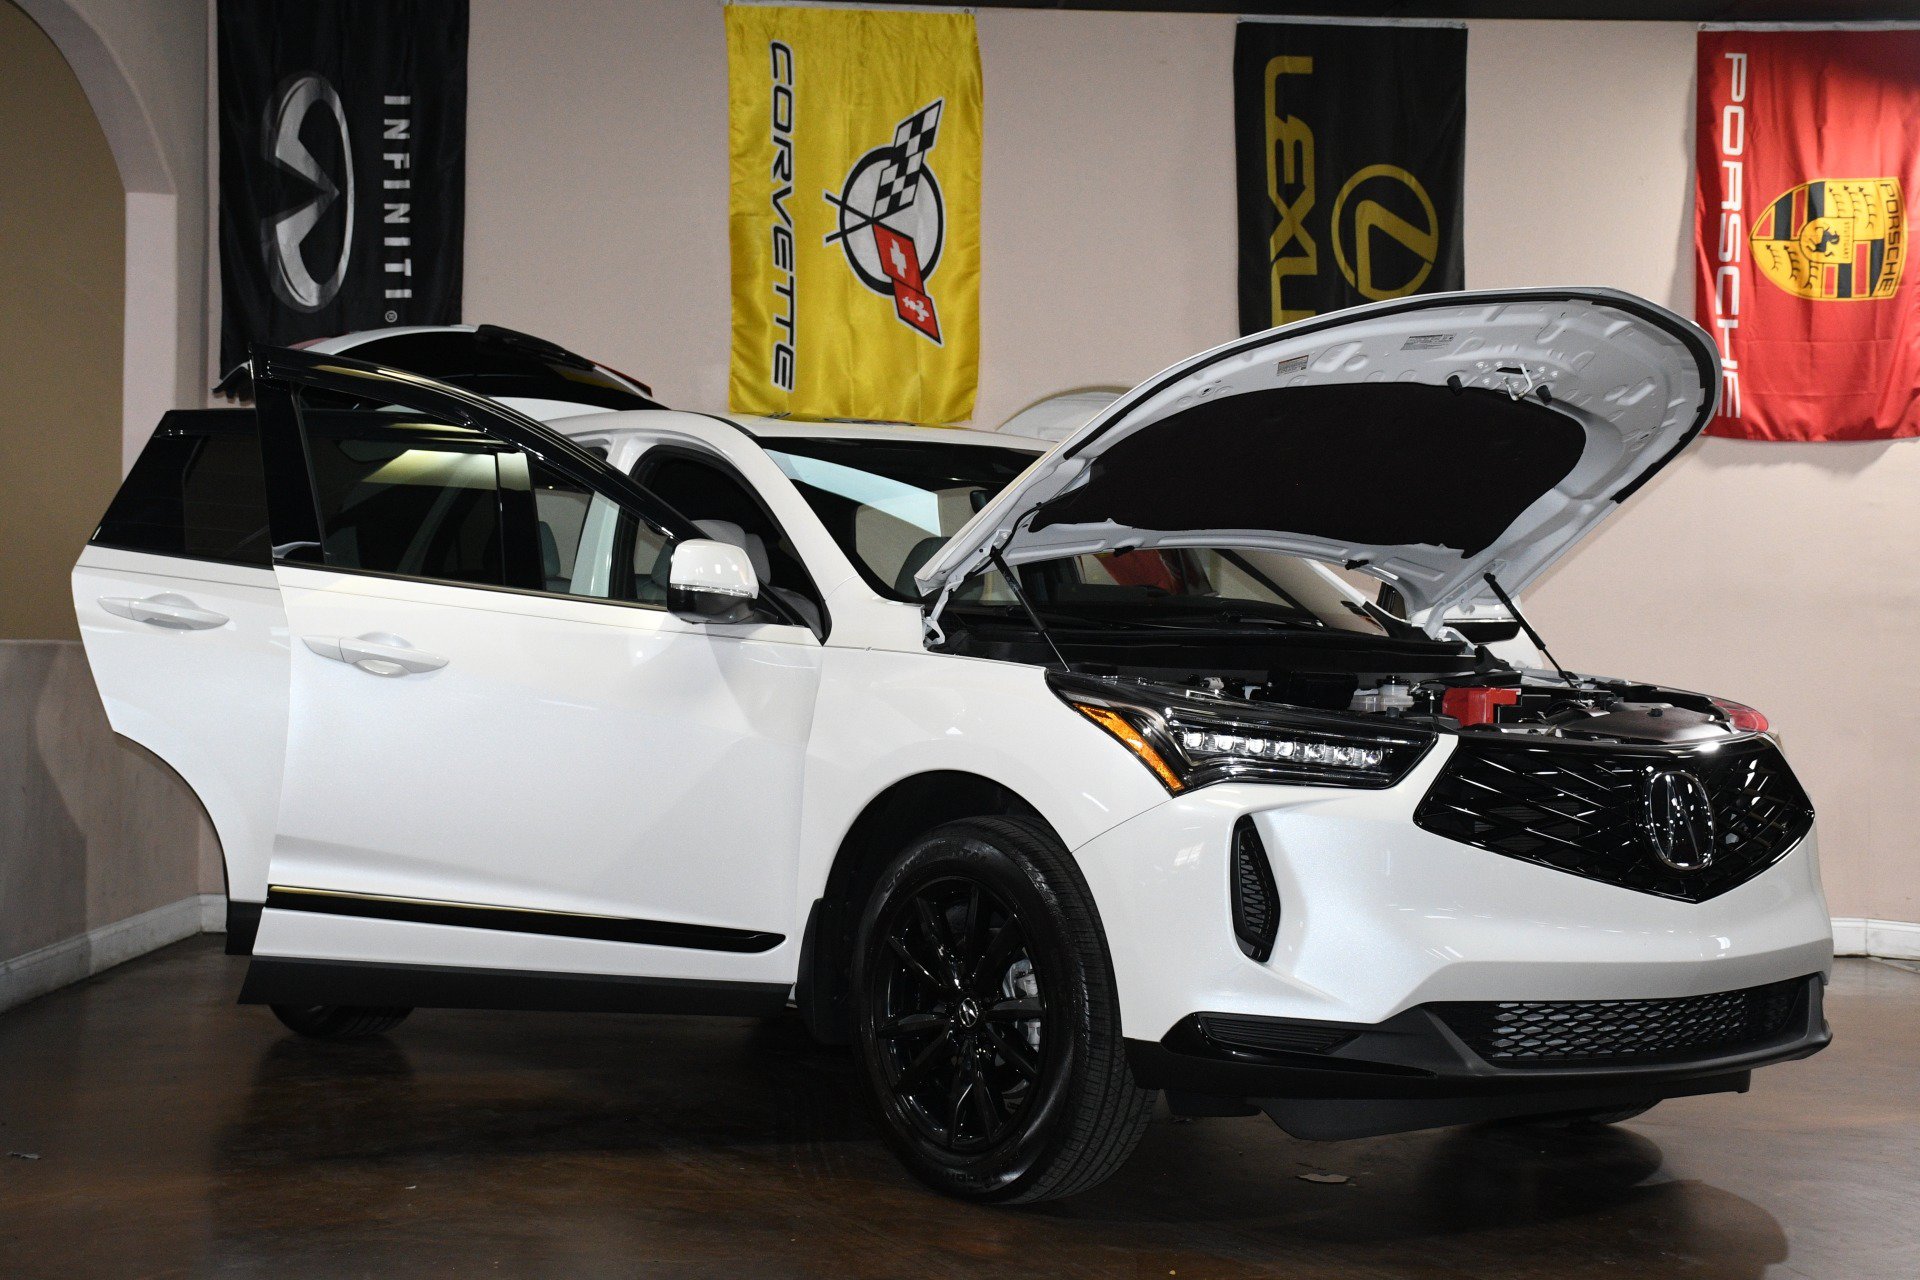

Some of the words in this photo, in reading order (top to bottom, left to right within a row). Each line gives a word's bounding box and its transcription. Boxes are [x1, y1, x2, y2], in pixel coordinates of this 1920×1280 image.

[383, 95, 412, 299] INFINITI
[770, 40, 794, 391] CORVETTE
[1264, 56, 1317, 327] LEXU
[1715, 52, 1747, 418] PORSCHE
[1879, 183, 1901, 291] PORSCHE
